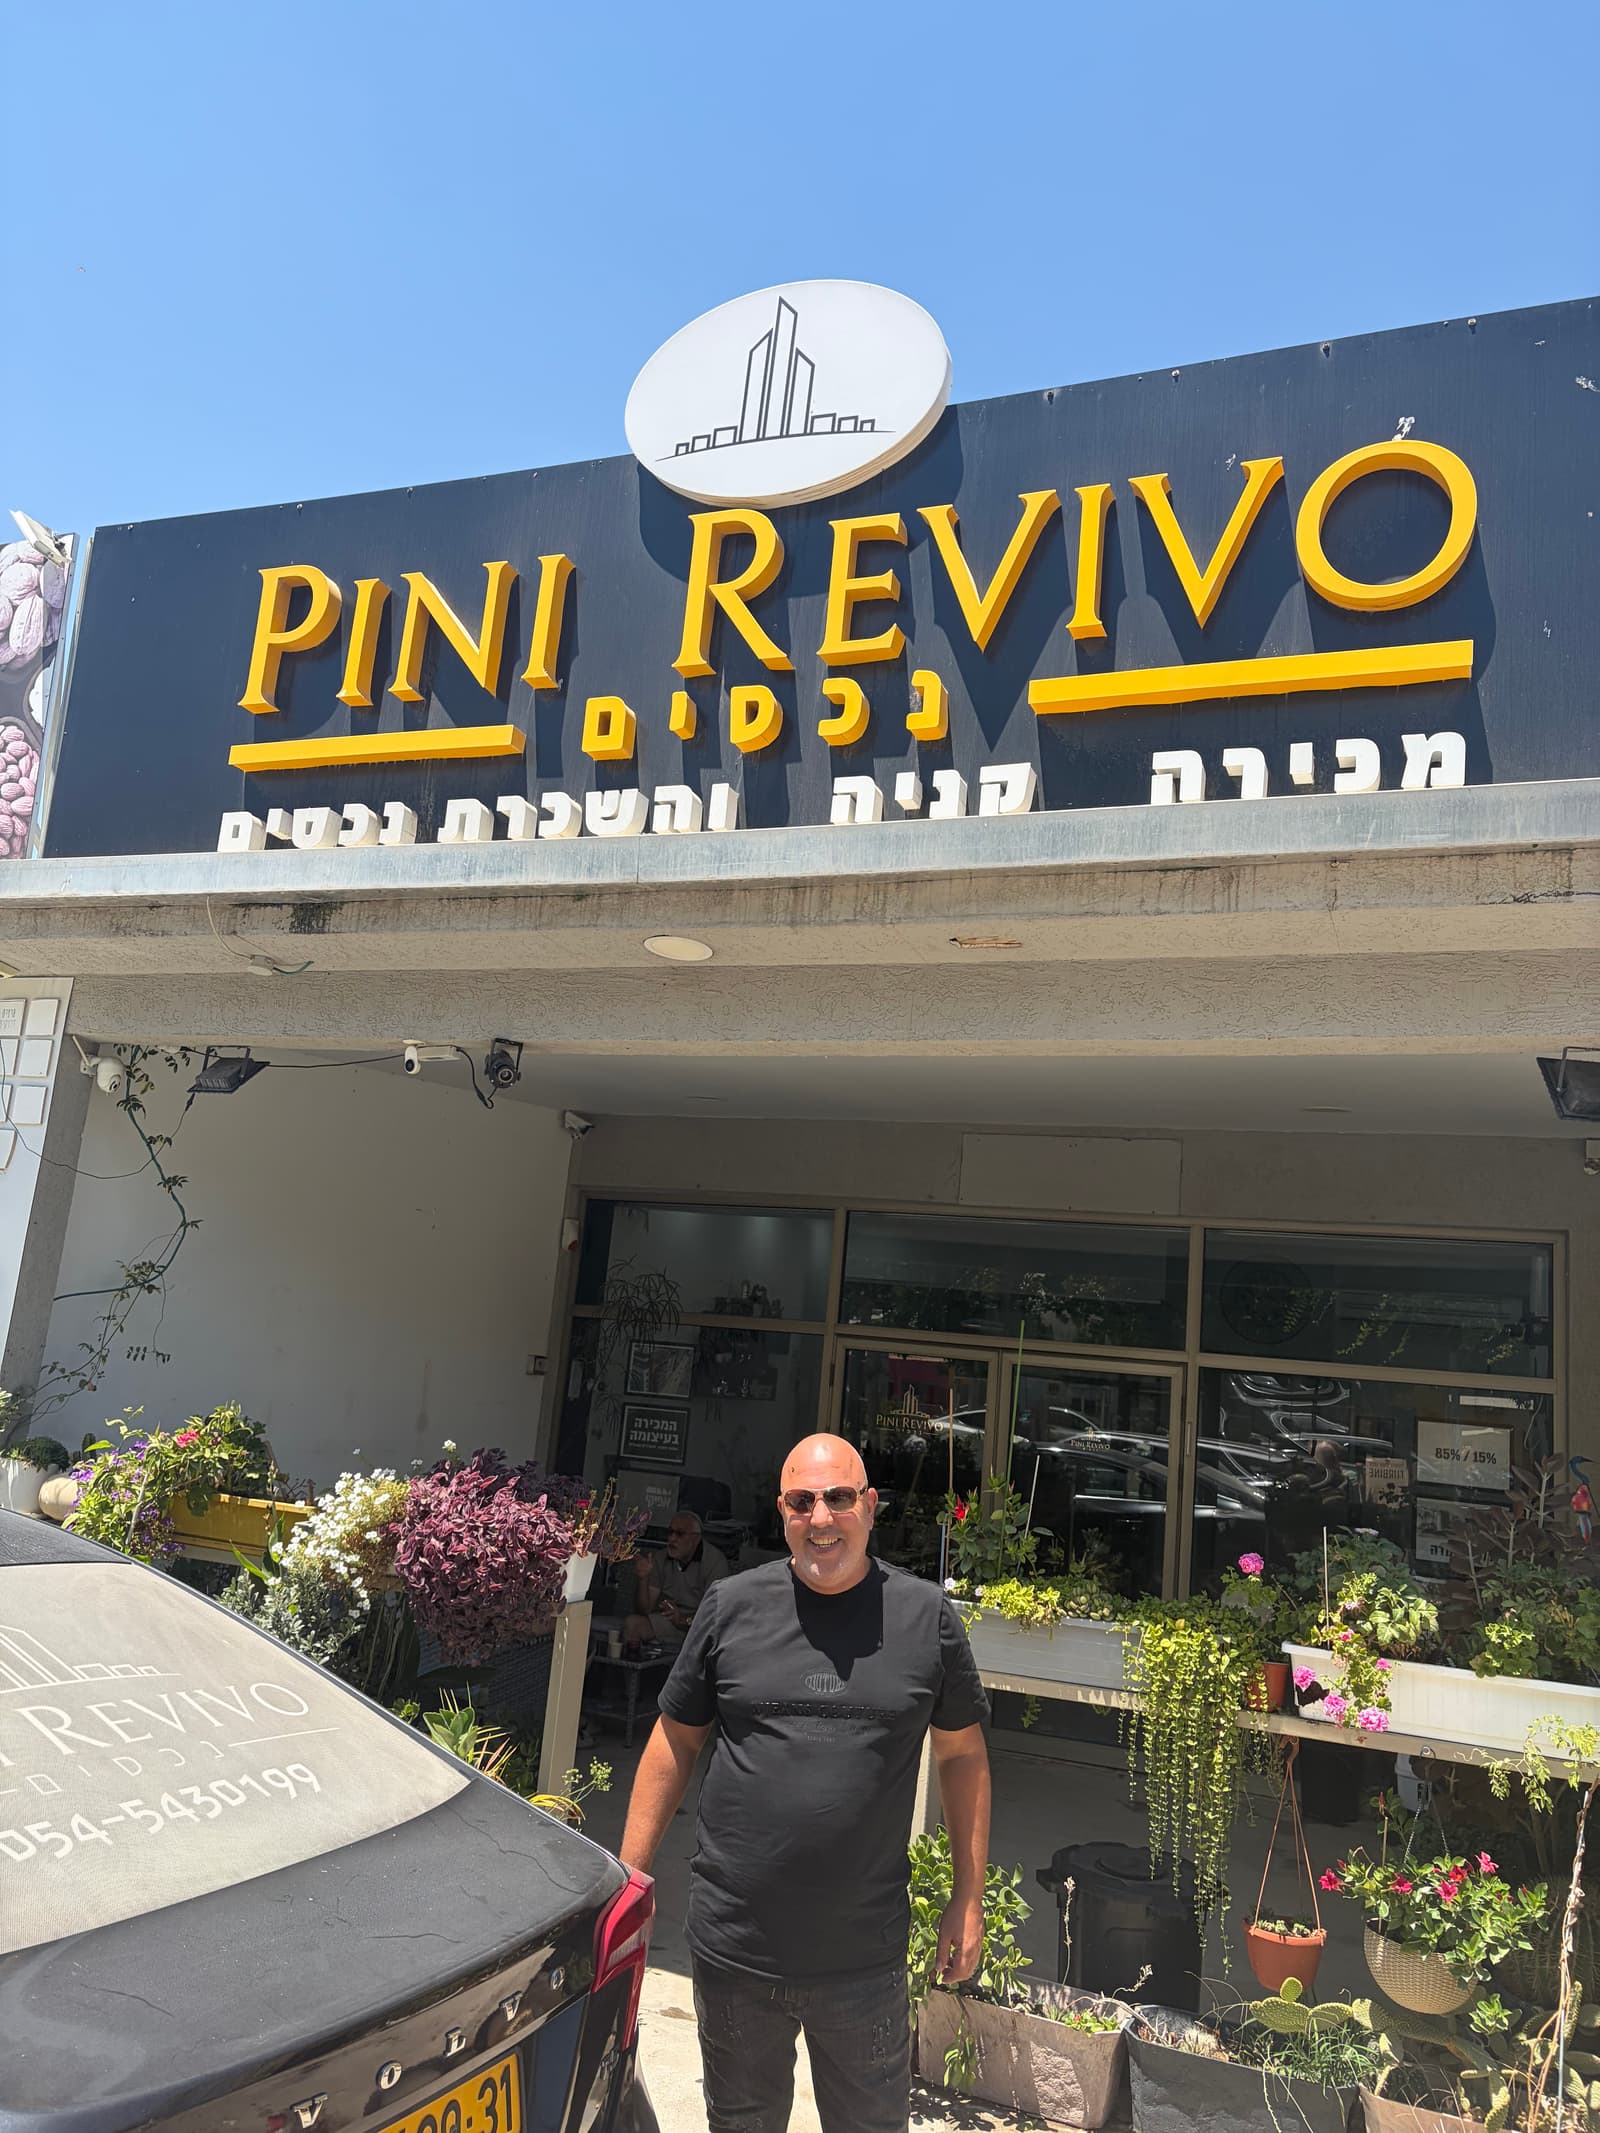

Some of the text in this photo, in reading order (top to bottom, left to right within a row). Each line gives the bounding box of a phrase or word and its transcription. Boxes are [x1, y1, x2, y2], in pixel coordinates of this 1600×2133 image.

[238, 440, 1478, 713] PINI REVIVO
[582, 669, 949, 761] נכסים
[217, 731, 1467, 852] מכירה קניה והשכרת נכסים
[629, 1430, 679, 1445] בעיצומה
[634, 1417, 677, 1431] המכירה
[876, 1414, 944, 1432] PINI REVIVO
[1435, 1447, 1461, 1460] 85%
[1472, 1451, 1497, 1464] 15%
[13, 1683, 309, 1755] REVIVO
[25, 1740, 225, 1796] נכסים
[0, 1763, 321, 1862] 054-5430199
[290, 1966, 567, 2129] VOLVO
